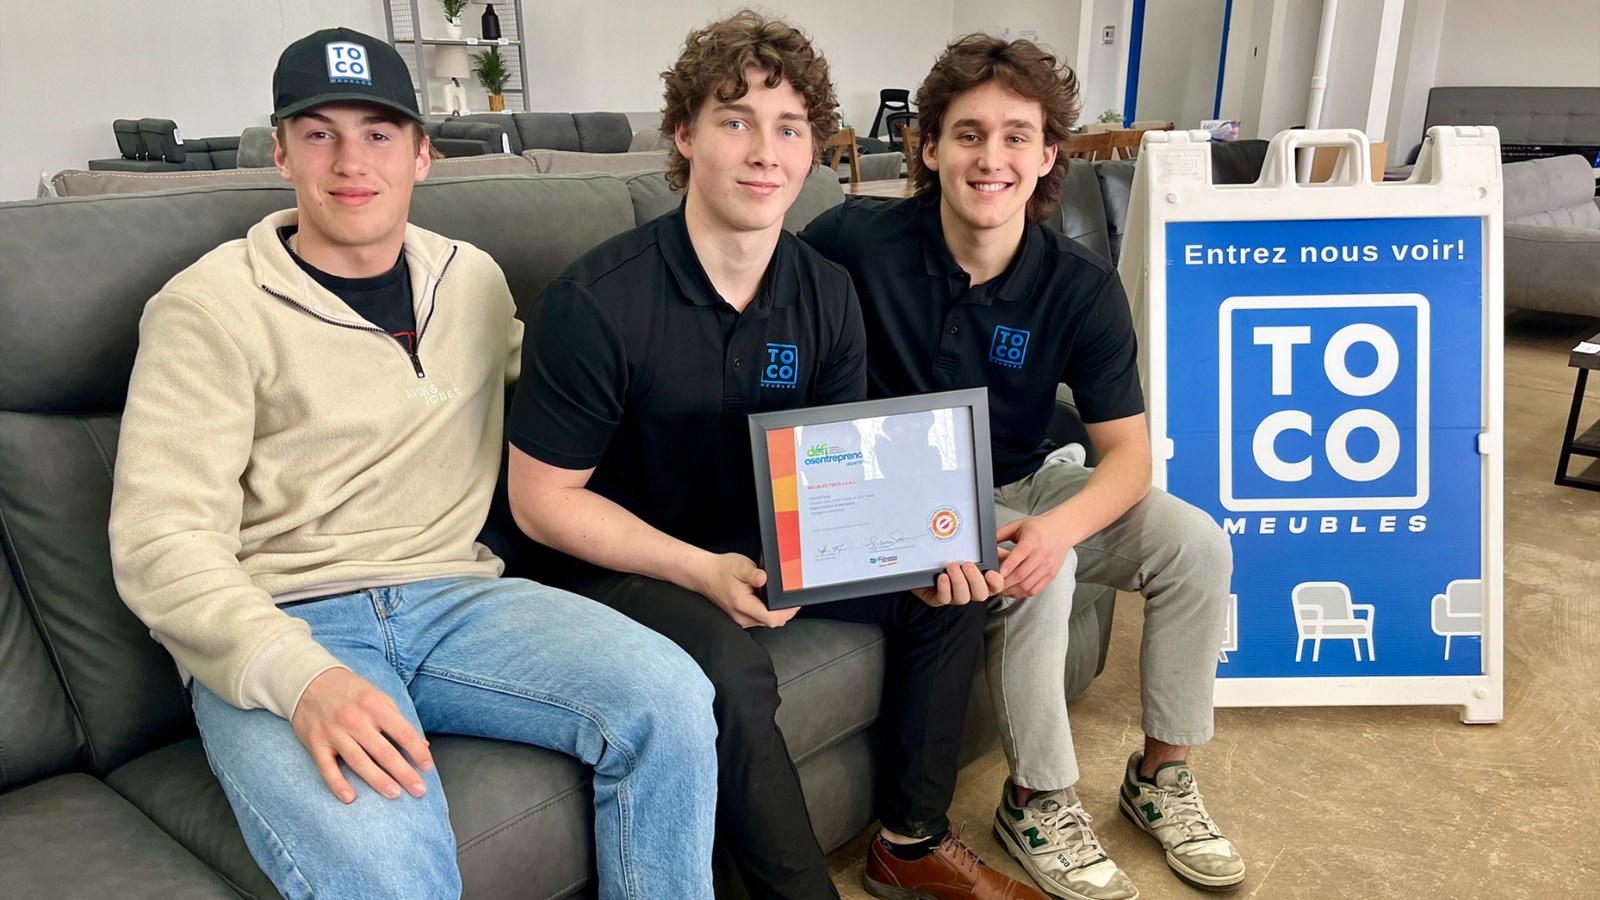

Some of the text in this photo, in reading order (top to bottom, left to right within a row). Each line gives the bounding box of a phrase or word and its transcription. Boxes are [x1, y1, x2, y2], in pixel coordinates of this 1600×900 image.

[332, 46, 362, 60] TO
[335, 61, 364, 75] CO
[1184, 239, 1464, 265] Entrez nous voir!
[1000, 331, 1024, 347] TO
[768, 349, 794, 364] TO
[995, 344, 1021, 360] CO
[1253, 323, 1399, 397] TO
[766, 364, 793, 379] CO
[806, 444, 828, 457] défi
[1252, 408, 1400, 482] CO
[1222, 515, 1427, 535] MEUBLES
[1056, 853, 1071, 868] 550
